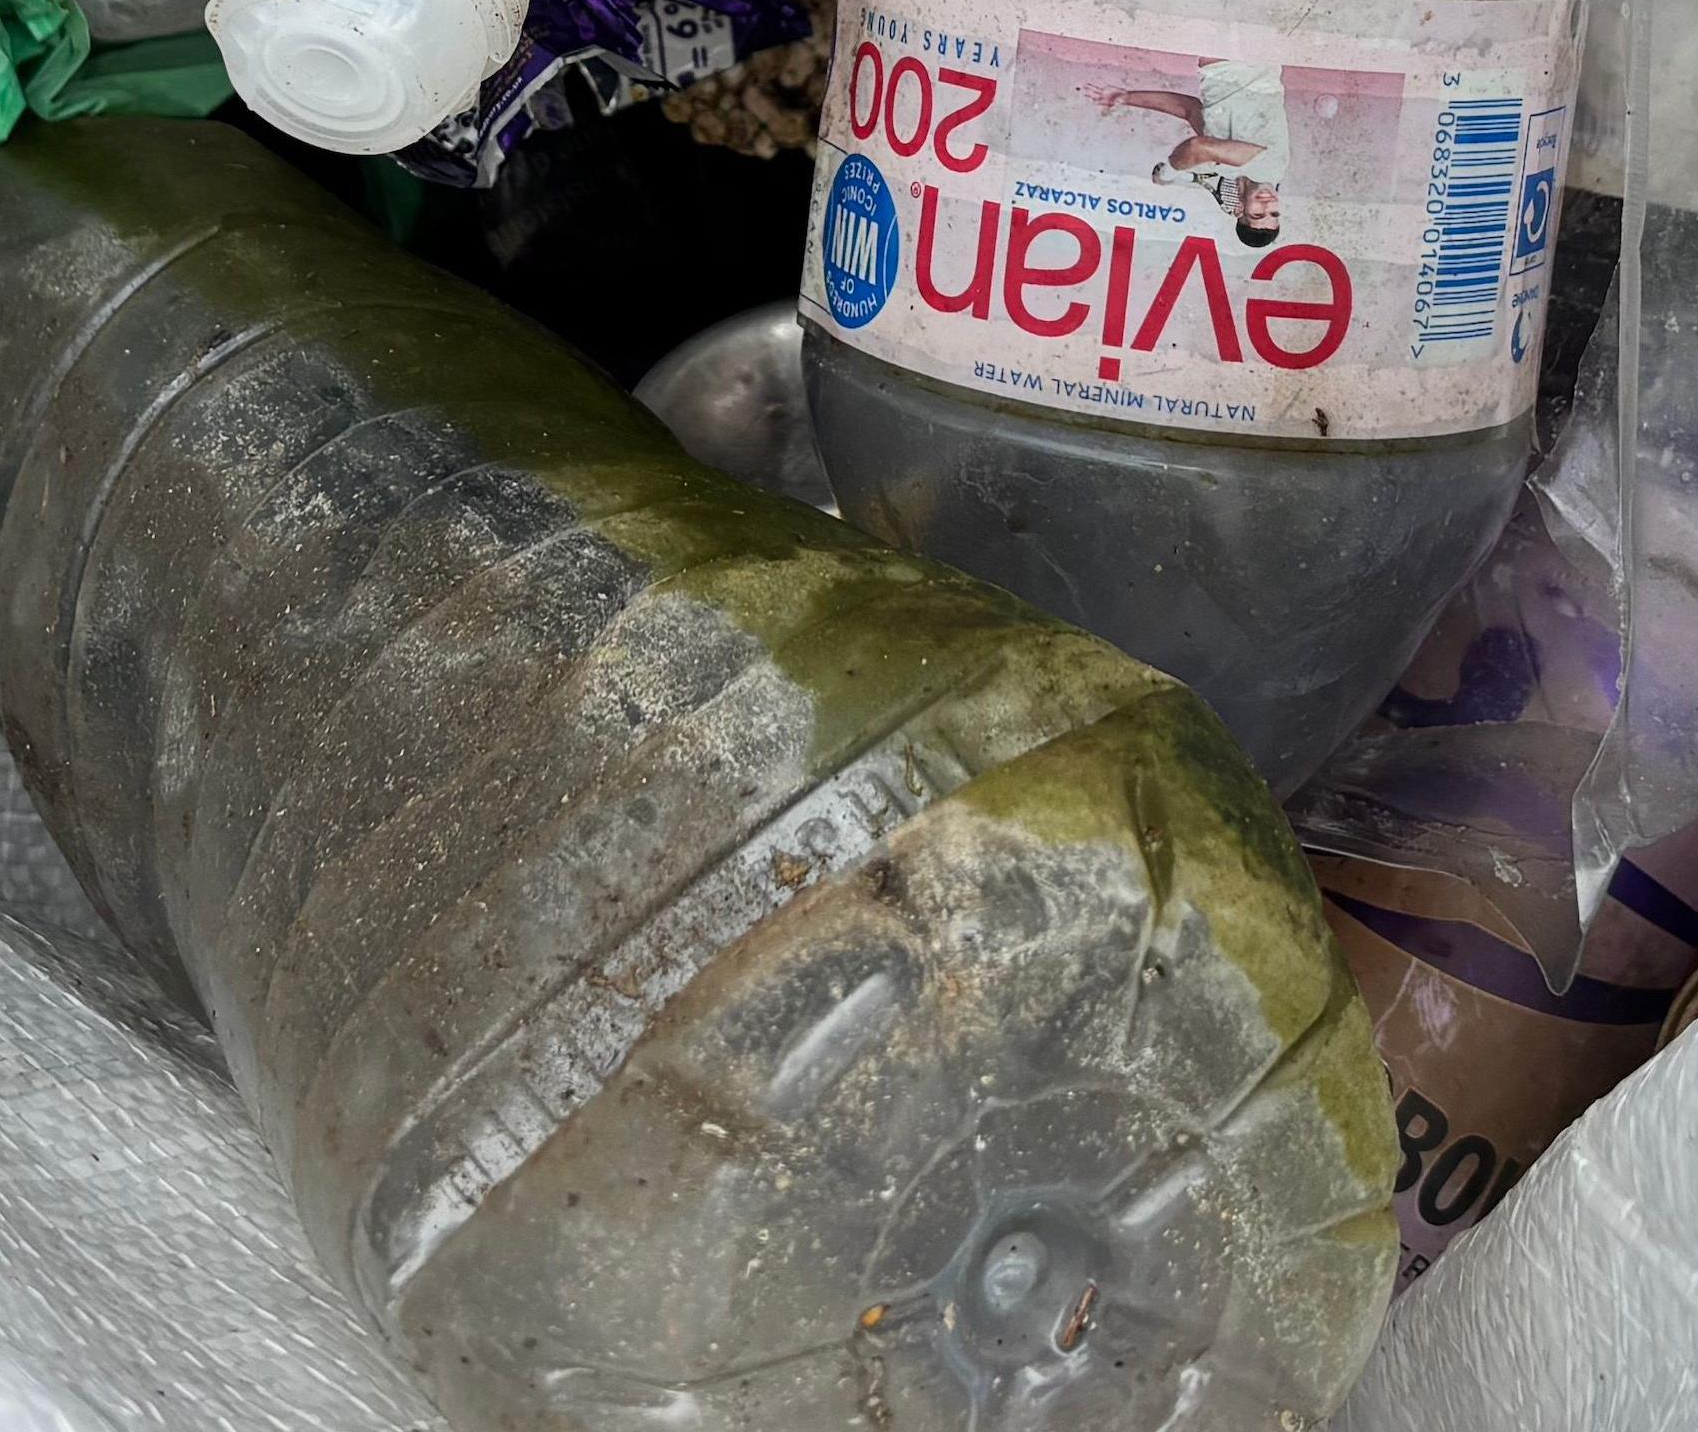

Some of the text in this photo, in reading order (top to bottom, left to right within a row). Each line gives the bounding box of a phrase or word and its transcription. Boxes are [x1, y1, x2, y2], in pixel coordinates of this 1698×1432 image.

[860, 11, 1000, 67] YEARS YOUNG
[849, 41, 998, 173] 200
[841, 186, 877, 217] ICONIC
[845, 161, 880, 194] PRIZES
[1015, 180, 1187, 224] CARLOS ALCARAZ
[831, 204, 879, 286] WIN
[827, 270, 878, 318] HUNDREDS
[841, 278, 854, 294] OF
[916, 185, 1353, 382] evian
[974, 359, 1256, 422] NATURAL MINERAL WATER
